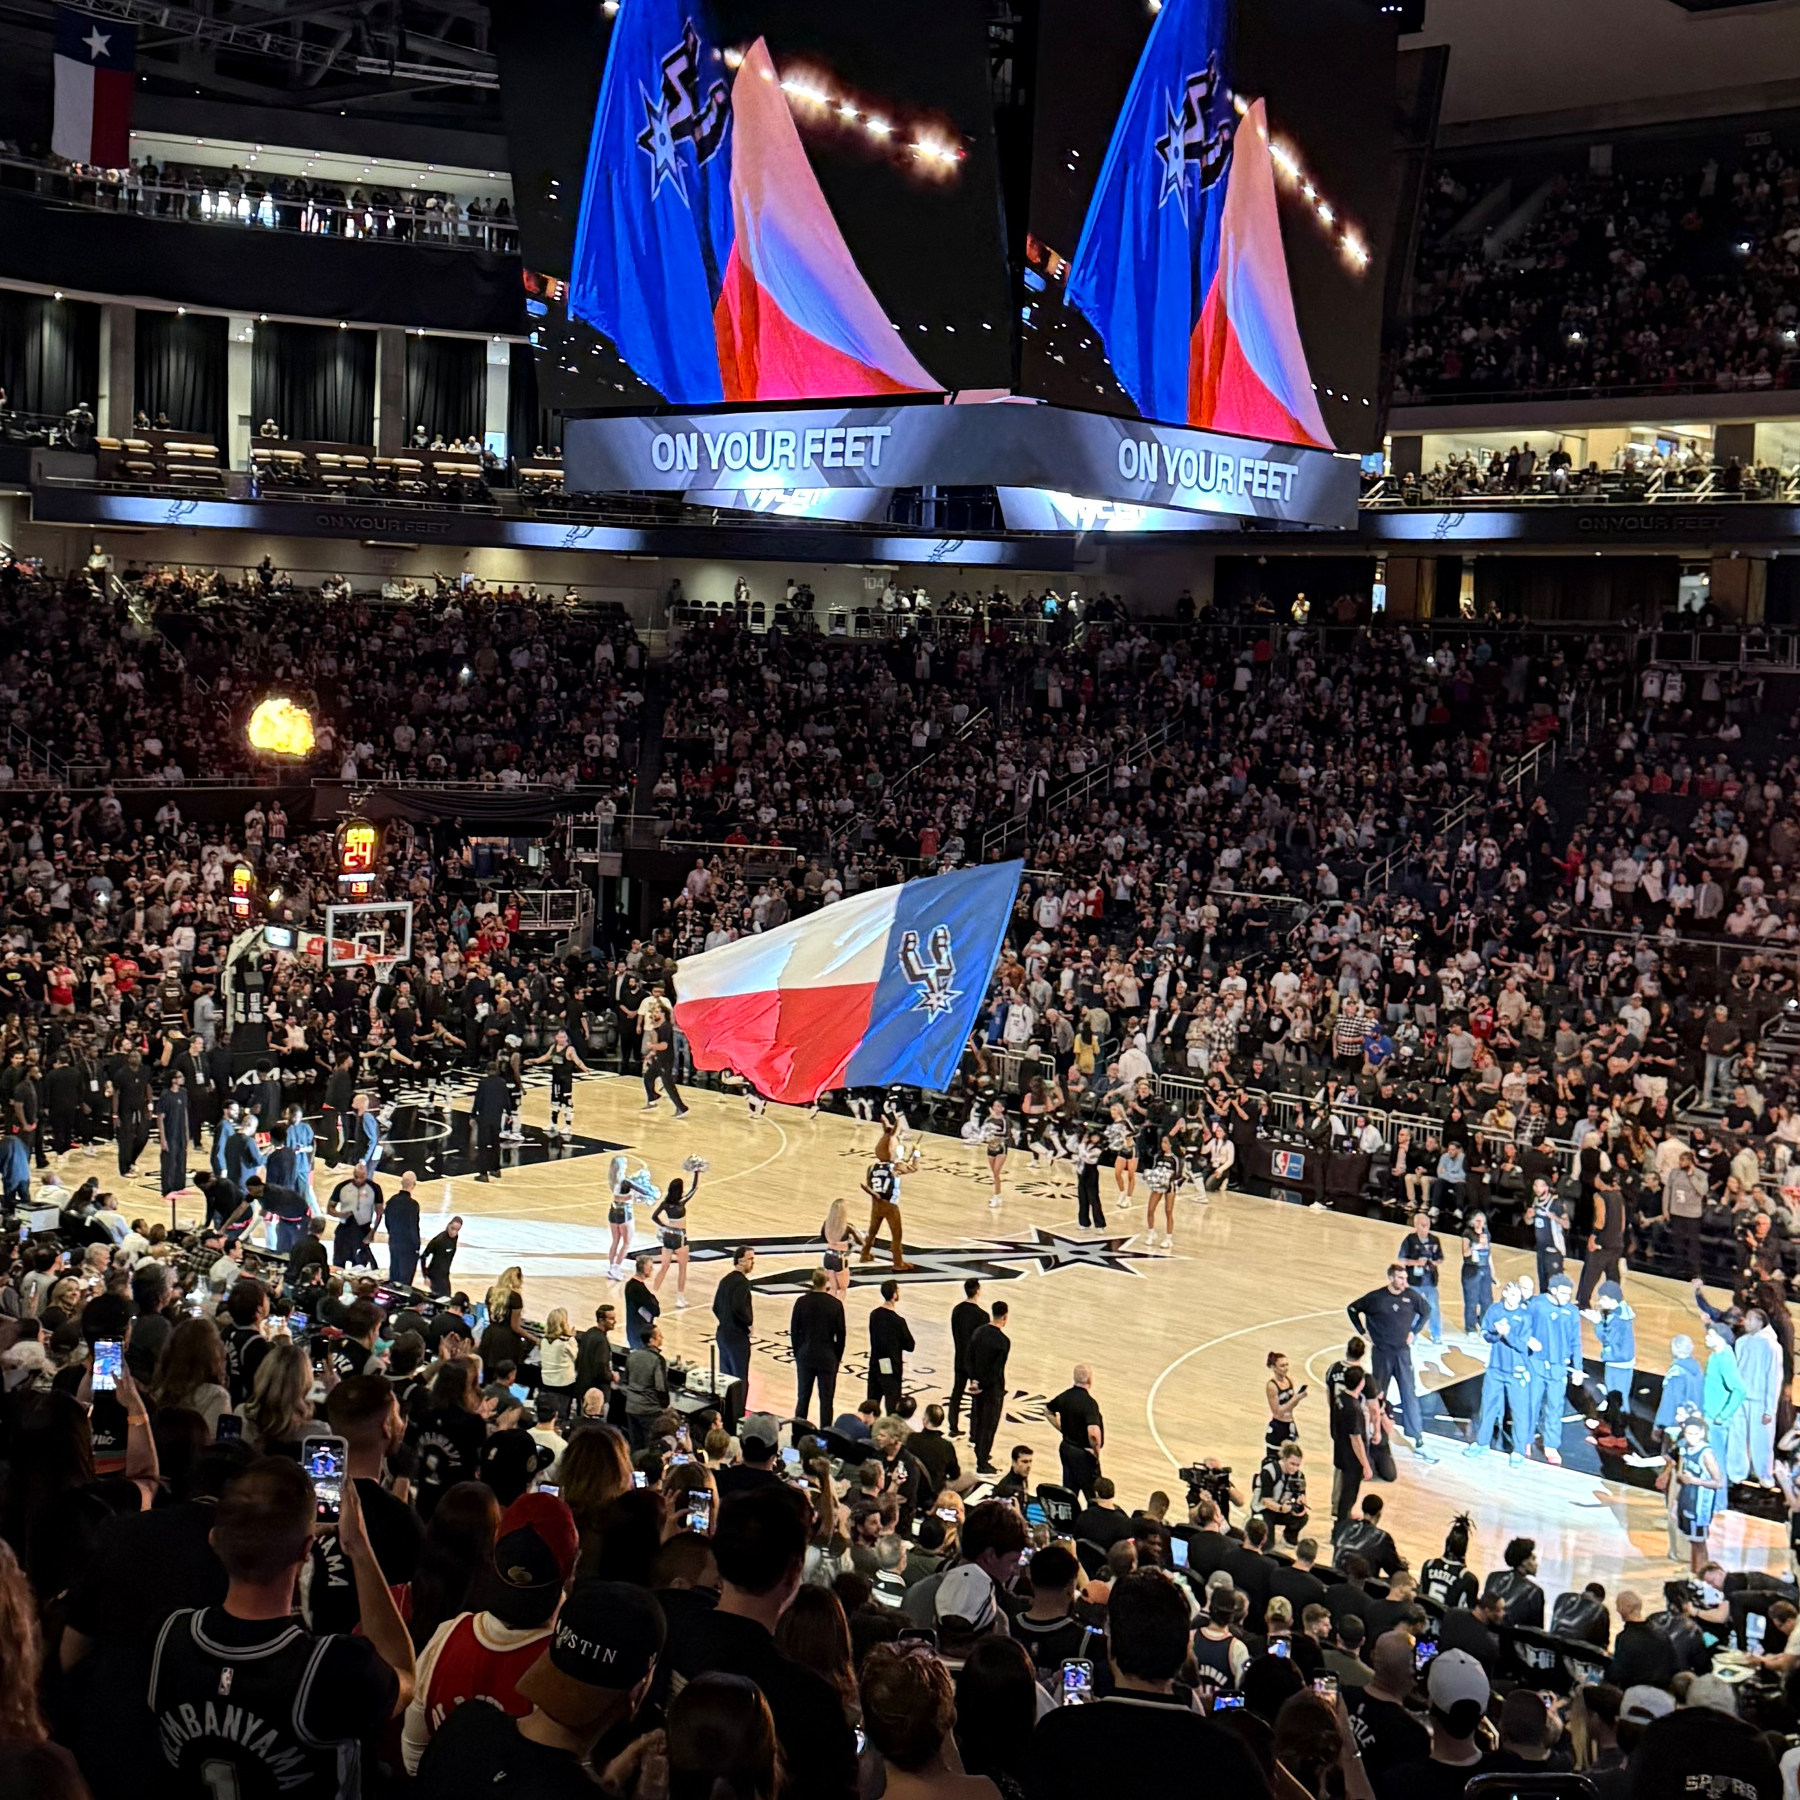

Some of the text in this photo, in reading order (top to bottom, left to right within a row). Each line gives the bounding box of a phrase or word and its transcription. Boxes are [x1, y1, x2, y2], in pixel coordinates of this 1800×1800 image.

[651, 426, 892, 472] ON YOUR FEET
[1118, 438, 1299, 501] ON YOUR FEET
[316, 515, 450, 534] ON YOUR FEET
[1578, 516, 1727, 530] ON YOUR FEET
[862, 577, 885, 590] 104
[344, 842, 372, 866] 24
[1428, 1568, 1458, 1586] CASTLE
[1428, 1582, 1448, 1604] 5
[556, 1618, 618, 1664] STIN
[1348, 1714, 1376, 1749] STLE
[200, 1757, 241, 1800] 1
